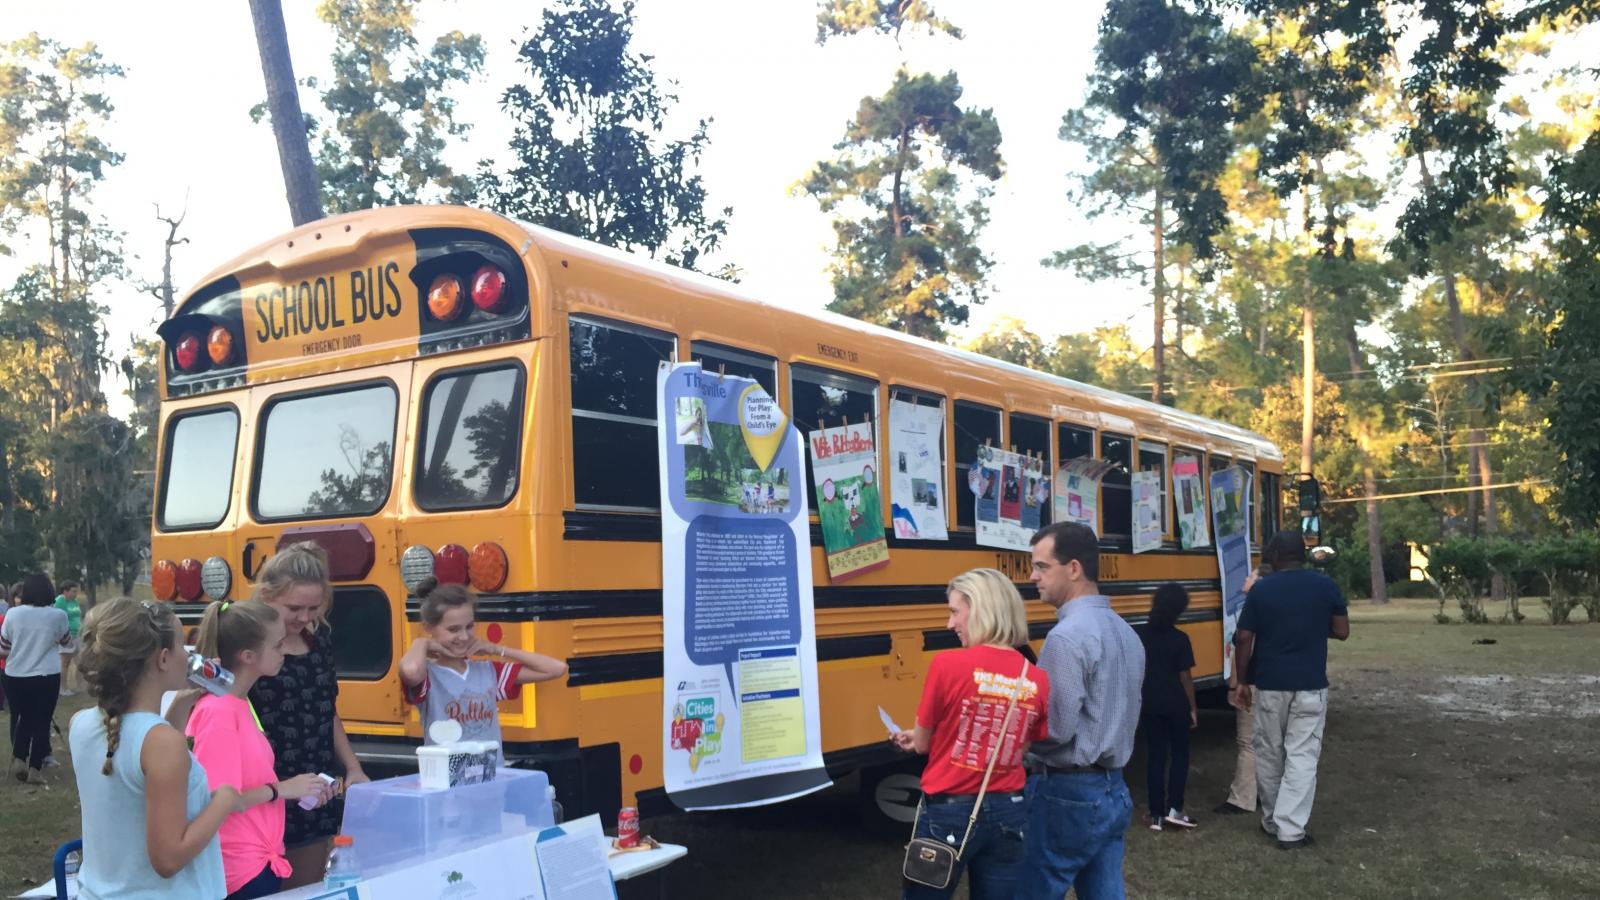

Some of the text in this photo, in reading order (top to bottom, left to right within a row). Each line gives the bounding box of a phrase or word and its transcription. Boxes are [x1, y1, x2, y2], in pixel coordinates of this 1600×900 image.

[255, 261, 402, 343] SCHOOL BUS
[302, 334, 362, 356] EMERGENCY DOOR
[816, 342, 860, 363] EMERGENCY EXIT
[746, 396, 774, 405] Planning
[746, 421, 777, 429] Child's Eye
[686, 702, 714, 716] Cities
[705, 721, 714, 733] in
[695, 737, 721, 754] Play
